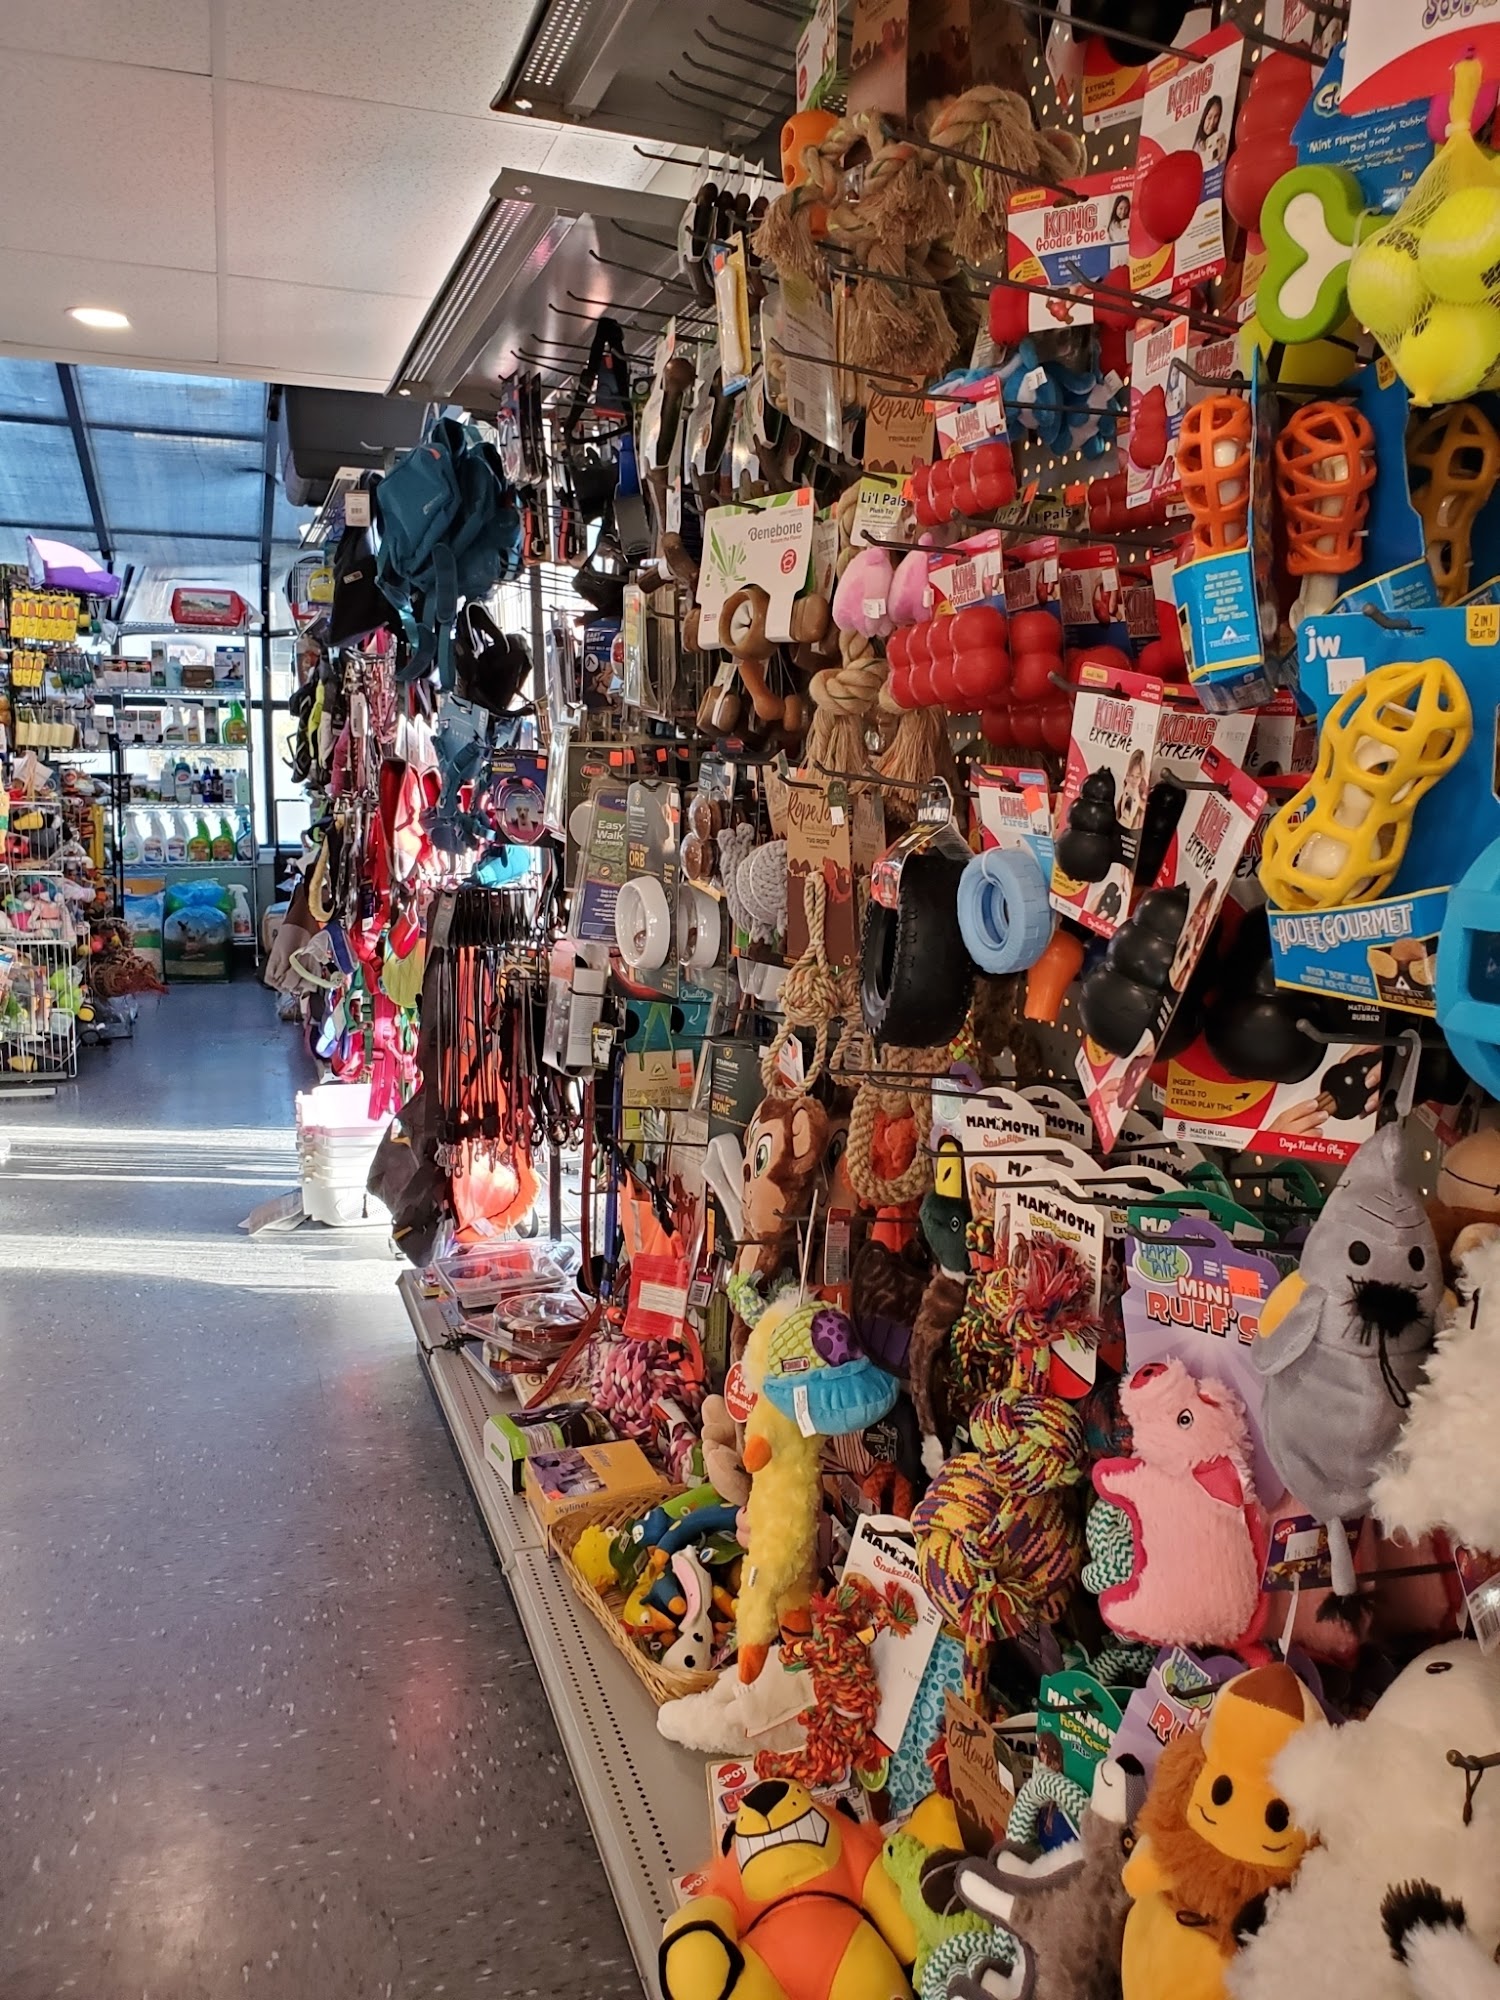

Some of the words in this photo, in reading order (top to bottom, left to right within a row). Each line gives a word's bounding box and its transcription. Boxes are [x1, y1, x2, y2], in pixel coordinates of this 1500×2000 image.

[1085, 79, 1115, 94] EXTREME
[1166, 63, 1214, 115] KONG
[1088, 88, 1116, 104] BOUNCE
[1175, 99, 1200, 122] Ball
[1373, 121, 1397, 135] Tough
[1044, 203, 1098, 239] KONG
[1036, 233, 1072, 251] Goodie
[1076, 229, 1106, 246] Bone
[955, 409, 980, 437] KONG
[861, 492, 881, 504] Li'l
[883, 493, 906, 507] Pals
[1043, 507, 1072, 522] Pals
[748, 522, 803, 541] Benebone
[951, 563, 977, 595] KONG
[1474, 614, 1480, 626] 2
[1481, 615, 1489, 627] IN
[1305, 626, 1341, 663] jw
[1146, 683, 1161, 691] POWER
[1094, 698, 1135, 737] KONG
[1089, 726, 1133, 753] EXTREME
[1158, 714, 1217, 748] KONG
[1155, 742, 1206, 760] XTREM
[598, 820, 626, 832] Easy
[1002, 816, 1029, 829] Tires
[596, 830, 624, 841] Walk
[816, 838, 831, 846] ROPE
[629, 851, 646, 868] ORB
[1185, 831, 1215, 879] EXTREME
[1348, 1004, 1381, 1013] NATURAL
[1351, 1013, 1380, 1022] RUBBER
[1172, 1078, 1196, 1087] INSERT
[1172, 1088, 1196, 1097] TREATS
[712, 1101, 731, 1115] BONE
[1171, 1098, 1197, 1107] EXTEND
[1198, 1100, 1215, 1109] PLAY
[1217, 1103, 1233, 1111] TIME
[966, 1115, 1040, 1137] MAMMOTH
[1190, 1127, 1207, 1135] MADE
[1279, 1137, 1297, 1152] Dogs
[1298, 1139, 1317, 1152] Need
[1317, 1143, 1326, 1153] to
[1017, 1192, 1096, 1238] MAMMOTH
[1140, 1243, 1178, 1265] HAPPY
[1151, 1260, 1179, 1279] TAILS
[1146, 1289, 1259, 1346] RUFF'S
[731, 1380, 739, 1395] 4
[555, 1501, 589, 1515] skyliner
[1274, 1523, 1297, 1541] SPOT
[1060, 1730, 1082, 1745] EXTRA
[1071, 1741, 1092, 1760] FRESH
[717, 1766, 747, 1786] SPOT
[680, 1874, 708, 1895] SPOT
